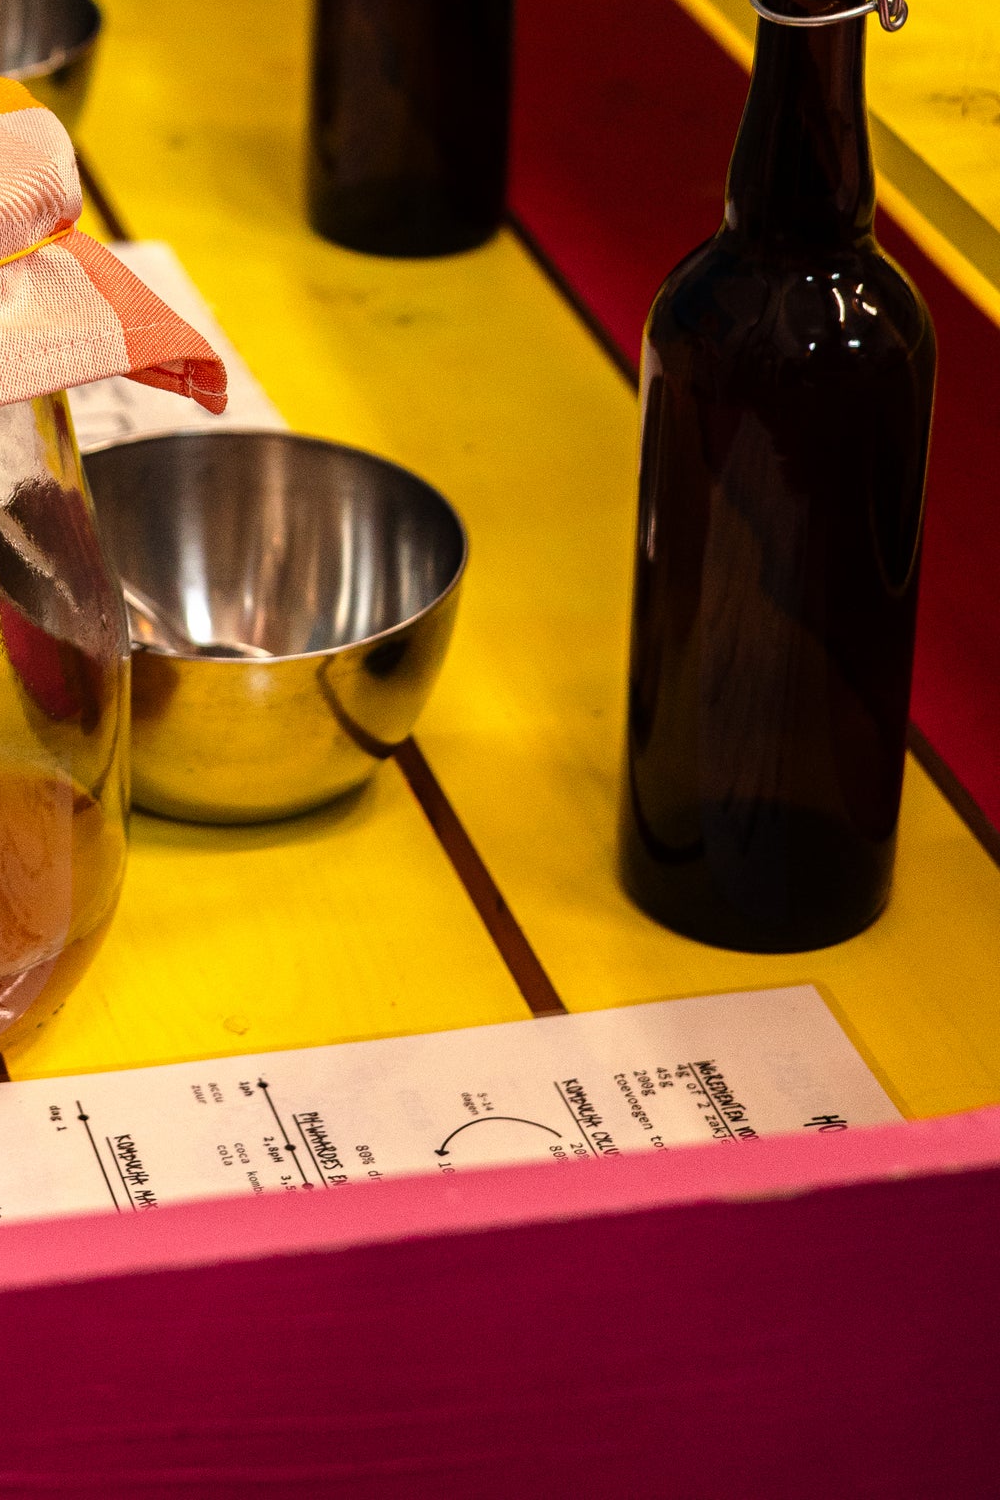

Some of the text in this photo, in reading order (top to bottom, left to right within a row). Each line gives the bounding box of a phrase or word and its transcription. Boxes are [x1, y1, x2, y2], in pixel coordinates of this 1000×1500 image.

[633, 1069, 656, 1097] 200g
[656, 1066, 674, 1088] 45g
[675, 1063, 690, 1079] 4g
[686, 1082, 707, 1096] of
[697, 1101, 710, 1110] 2
[190, 1084, 207, 1105] zuur
[461, 1092, 480, 1116] dagen
[613, 1072, 654, 1131] toevoegen
[49, 1104, 63, 1122] dag
[216, 1143, 234, 1167] cola
[233, 1142, 251, 1164] coca
[263, 1135, 284, 1163] 2,8pH
[355, 1144, 376, 1165] 80%
